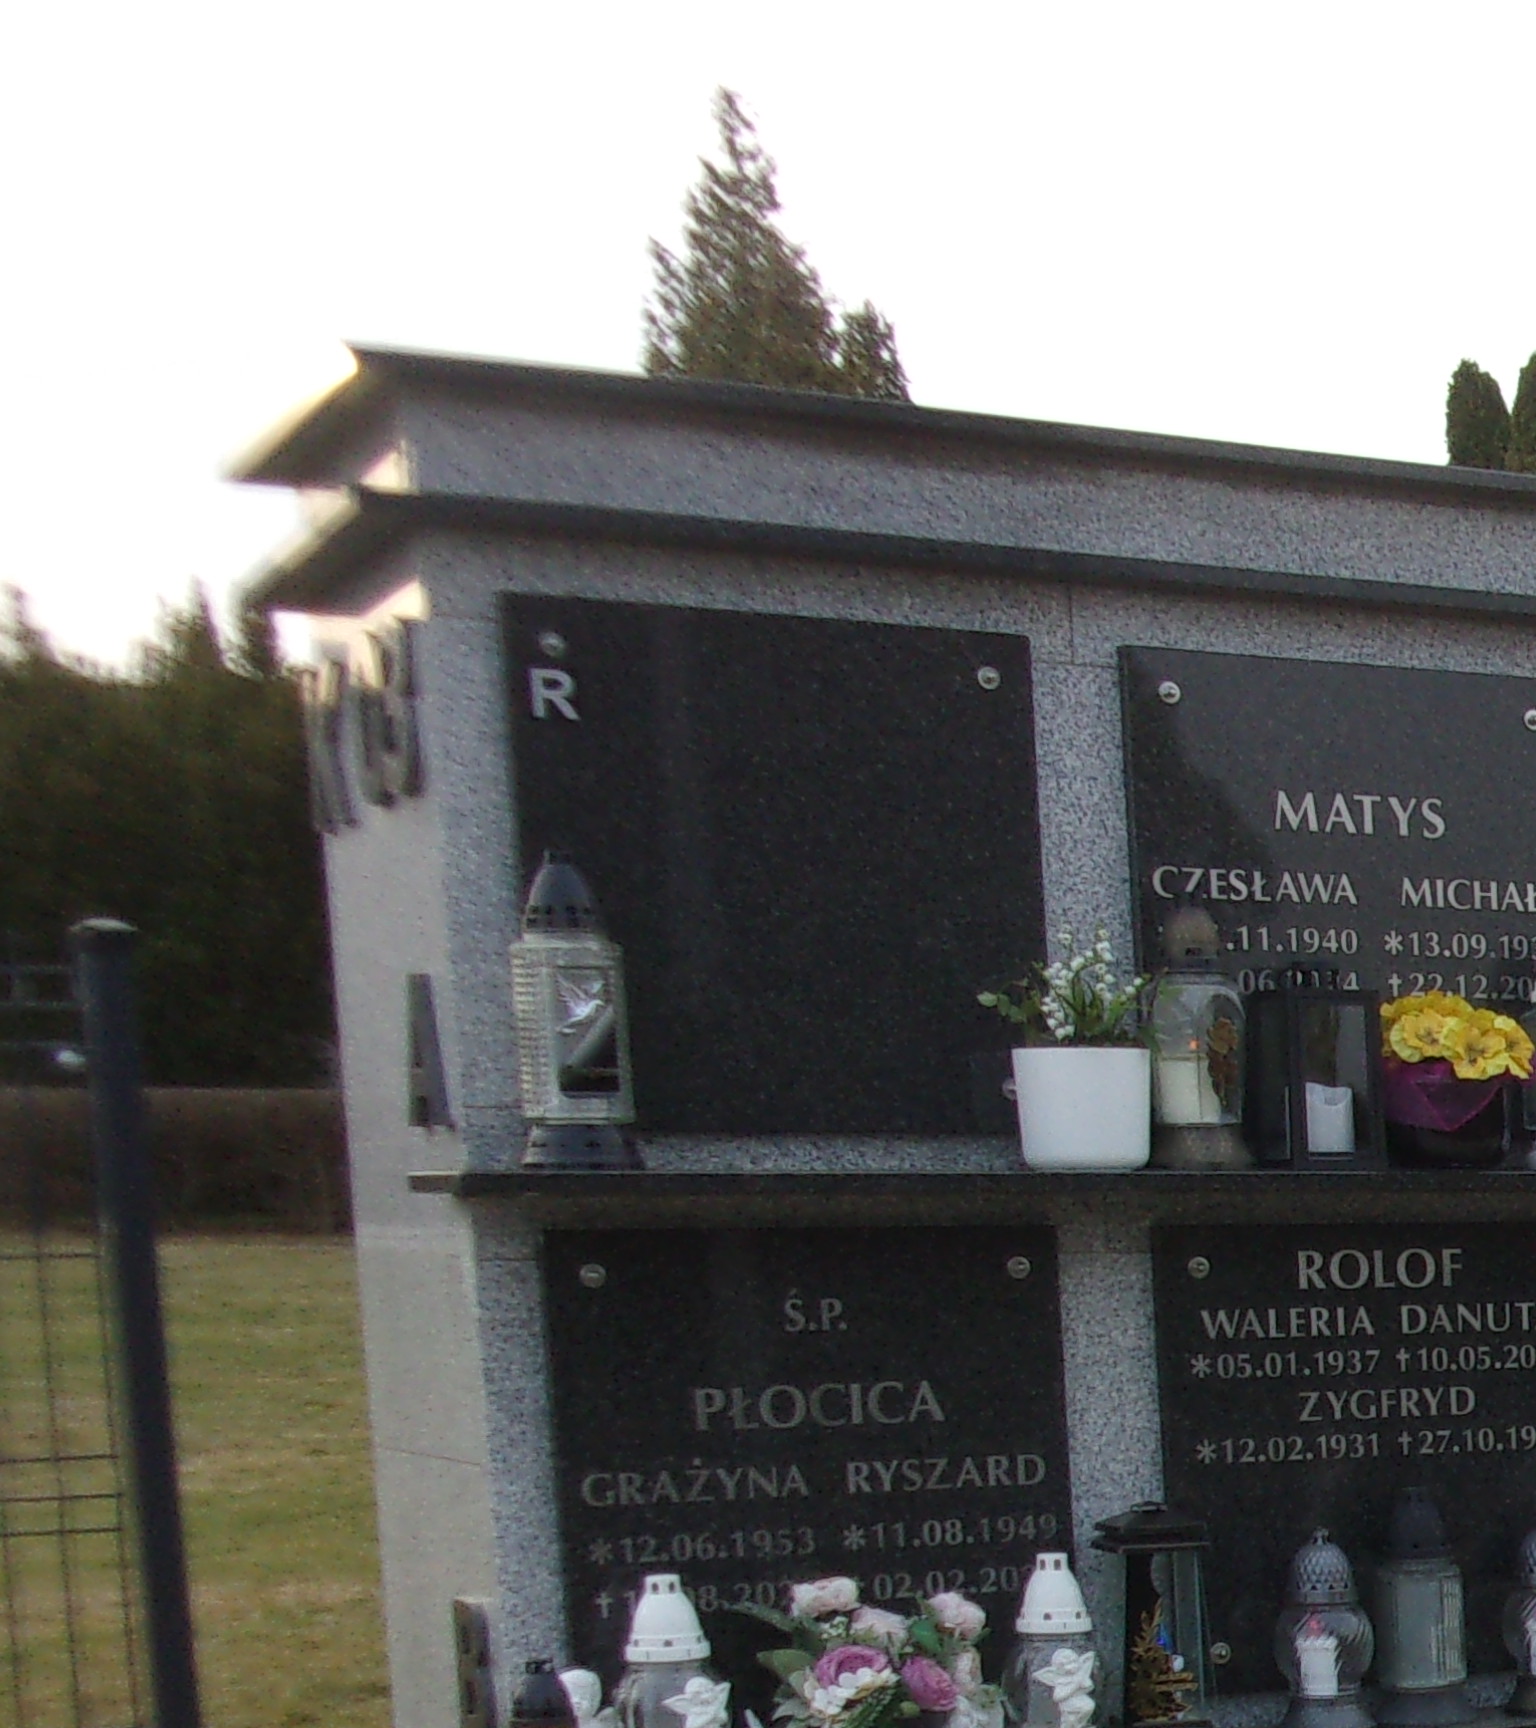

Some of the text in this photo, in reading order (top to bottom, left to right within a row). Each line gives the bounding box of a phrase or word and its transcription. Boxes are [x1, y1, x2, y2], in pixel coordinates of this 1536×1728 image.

[529, 667, 580, 720] R
[1274, 790, 1446, 839] MATYS
[1152, 865, 1358, 905] CZESŁAWA
[1298, 1248, 1463, 1290] ROLOF
[784, 1288, 848, 1331] Ś.P.
[1201, 1305, 1375, 1340] WALERIA
[695, 1380, 945, 1431] PŁOCICA
[1300, 1386, 1476, 1422] ZYGFRYD
[581, 1454, 1046, 1507] GRAŻYNA RYSZARD
